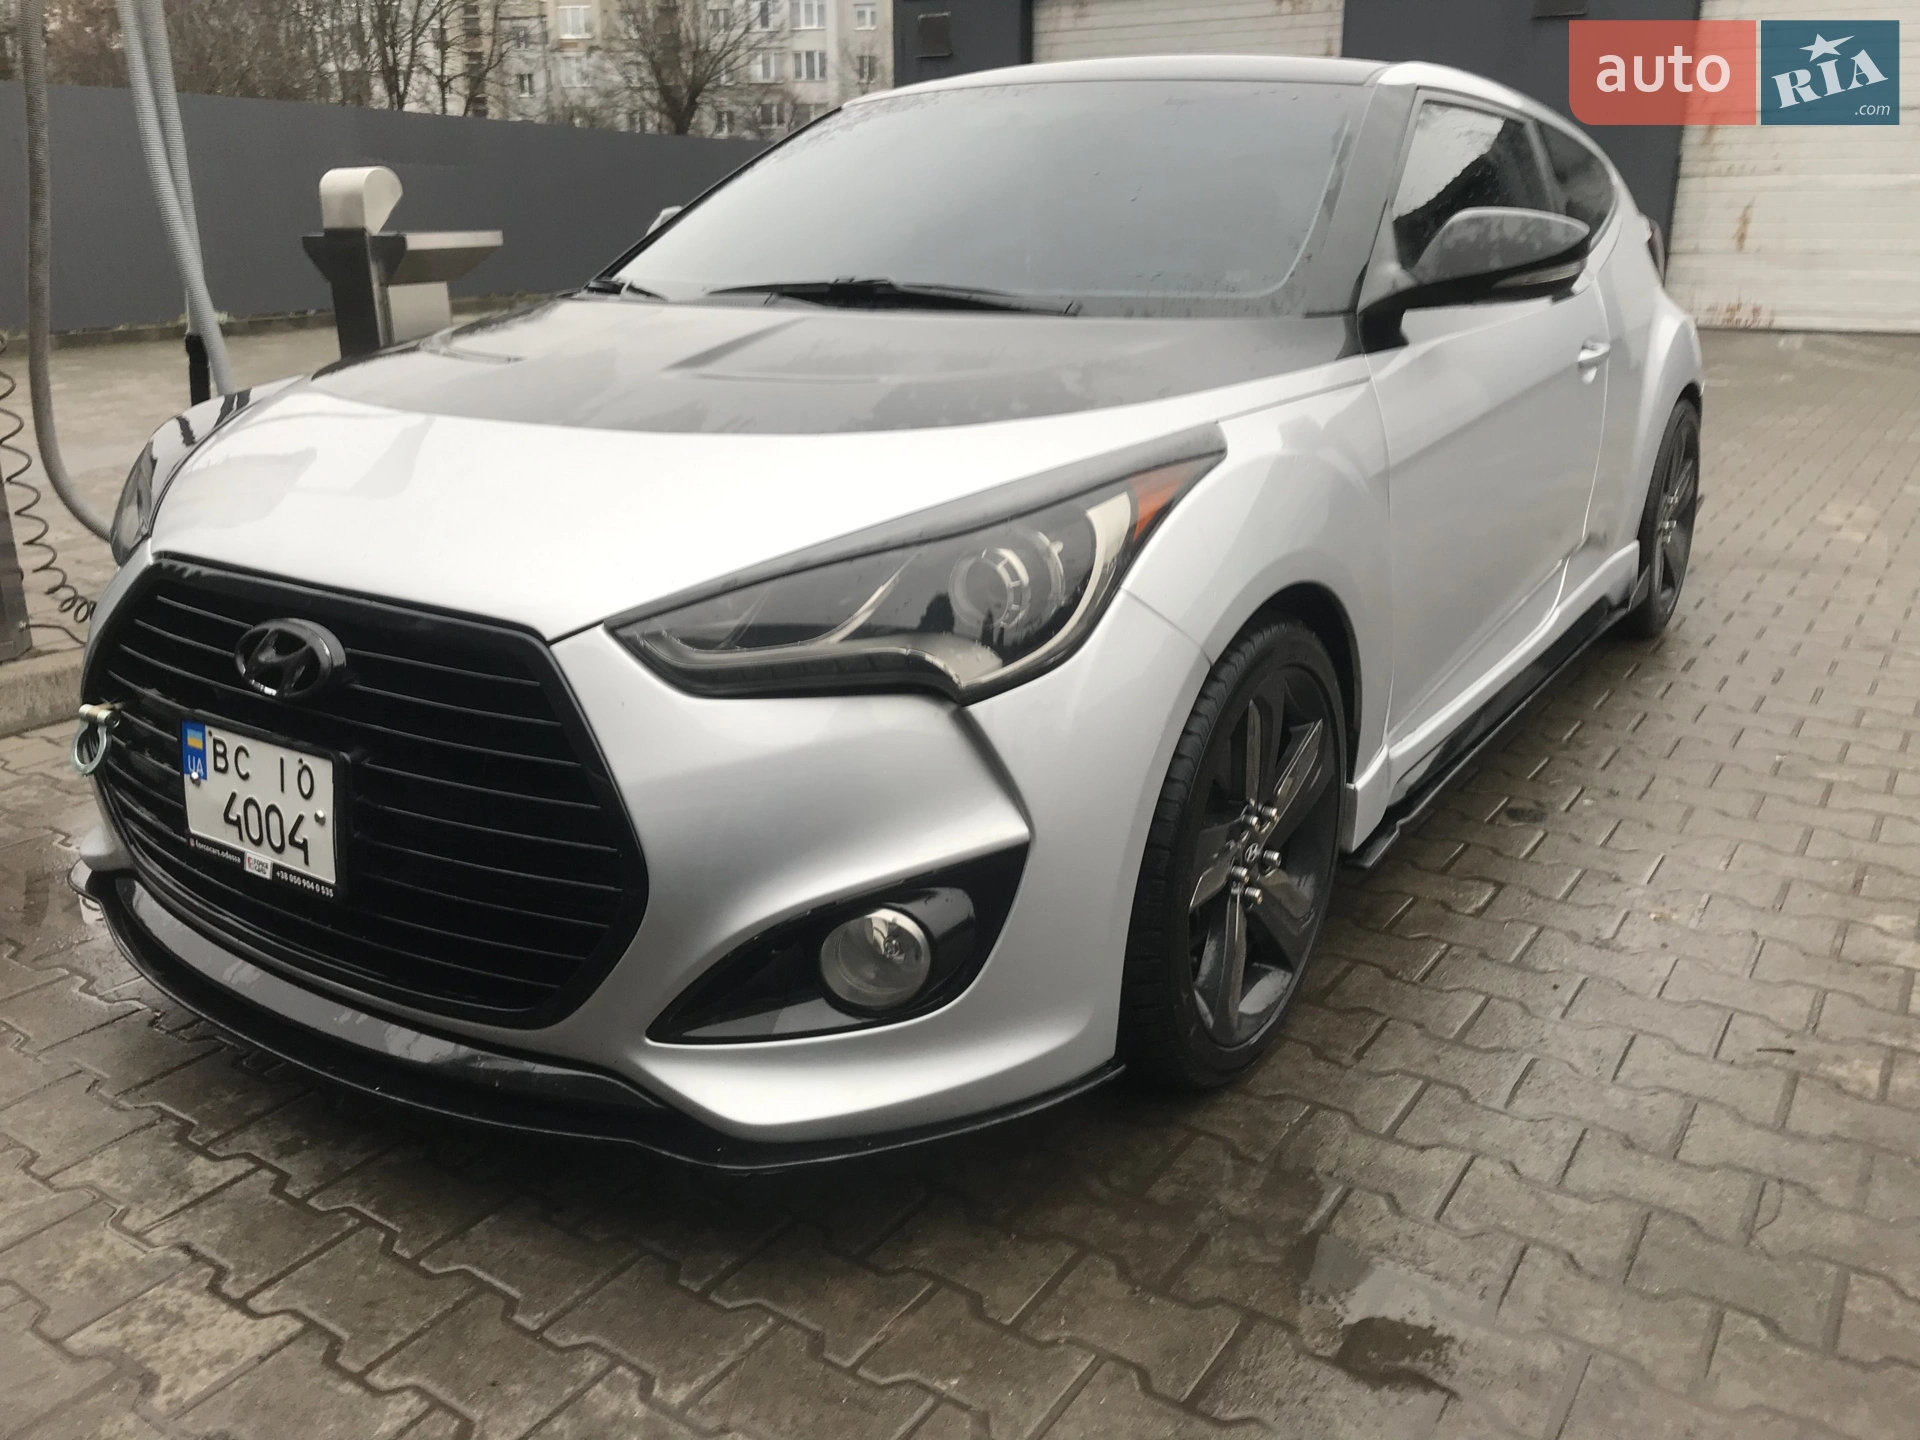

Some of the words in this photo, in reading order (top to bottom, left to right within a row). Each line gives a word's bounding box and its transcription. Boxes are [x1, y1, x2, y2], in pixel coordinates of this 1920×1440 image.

[187, 754, 204, 776] UA
[212, 737, 251, 781] BC
[223, 791, 310, 867] 4004
[276, 870, 288, 881] +38
[289, 874, 301, 886] 050
[302, 878, 315, 891] 904
[321, 885, 334, 898] 535
